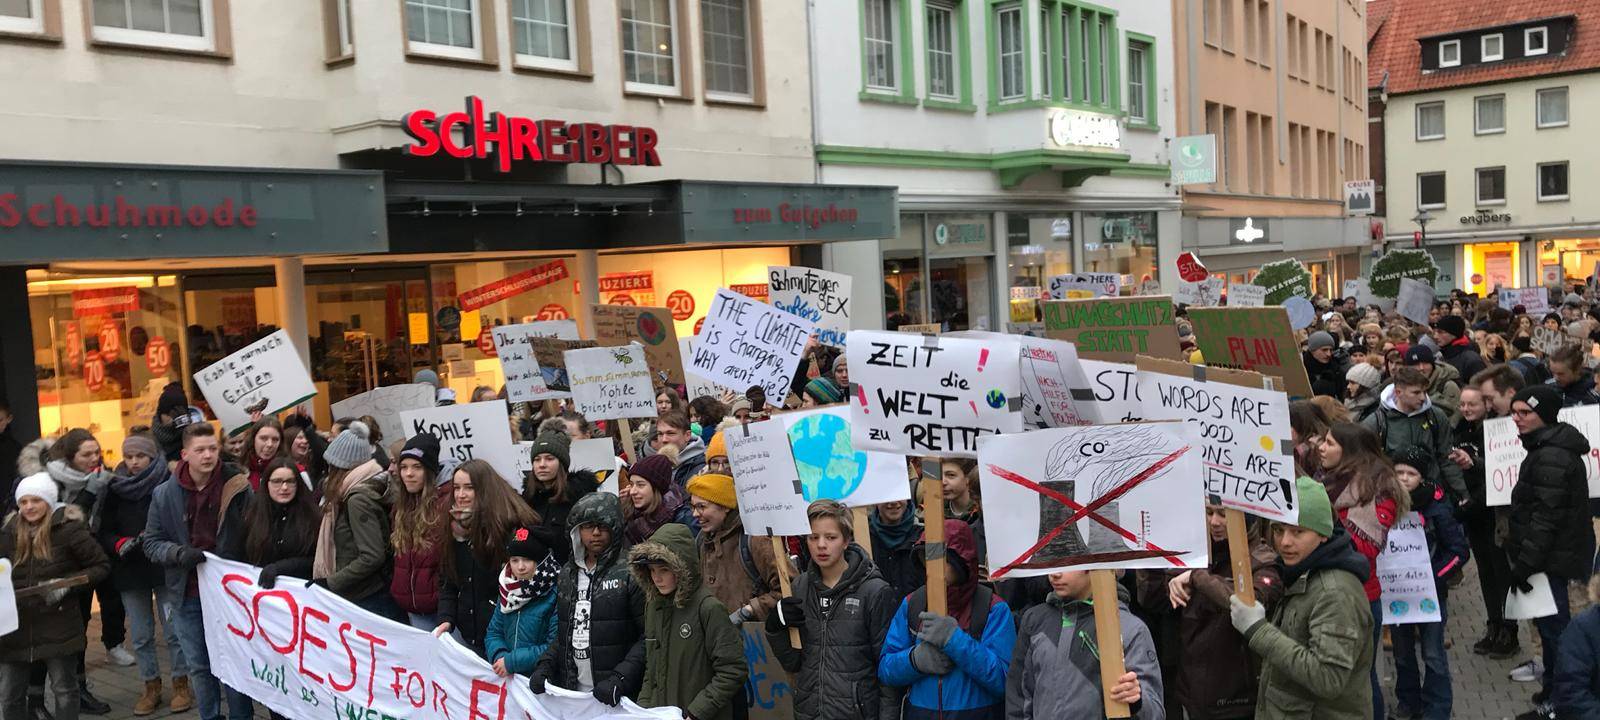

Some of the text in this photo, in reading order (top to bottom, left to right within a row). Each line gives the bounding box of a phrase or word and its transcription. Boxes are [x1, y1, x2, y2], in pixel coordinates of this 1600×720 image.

[401, 95, 661, 172] SCHREIBER
[0, 193, 257, 227] Schuhmode
[733, 203, 858, 229] zum Gutgehen
[1459, 212, 1512, 225] engbers
[1180, 262, 1200, 274] STO
[1374, 272, 1401, 282] PLANT
[1409, 267, 1430, 276] TREE
[464, 265, 564, 306] WINTERSCHLUSSVERKAUF
[770, 269, 840, 297] Schmutziger
[671, 302, 692, 315] 20
[719, 293, 752, 326] THE
[1044, 301, 1173, 331] KLIMASCHUTZ
[705, 324, 722, 345] is
[1077, 330, 1149, 352] STATT
[150, 348, 167, 367] 50
[693, 347, 720, 372] WHY
[866, 342, 945, 369] ZEIT
[1226, 337, 1281, 371] PLAN
[234, 364, 254, 379] zum
[940, 370, 971, 391] die
[581, 400, 654, 415] bringt uns um
[876, 387, 960, 419] WELT
[1158, 382, 1273, 428] WORDS ARE
[413, 418, 473, 441] KOHLE
[868, 427, 891, 441] zu
[1189, 418, 1239, 446] OOD.
[449, 444, 474, 462] IST
[1245, 453, 1282, 478] ARE
[1203, 467, 1293, 511] ETTER!
[602, 579, 619, 590] NYC
[221, 573, 388, 707] SOEST
[391, 666, 450, 720] FOR
[251, 658, 319, 707] Weil es
